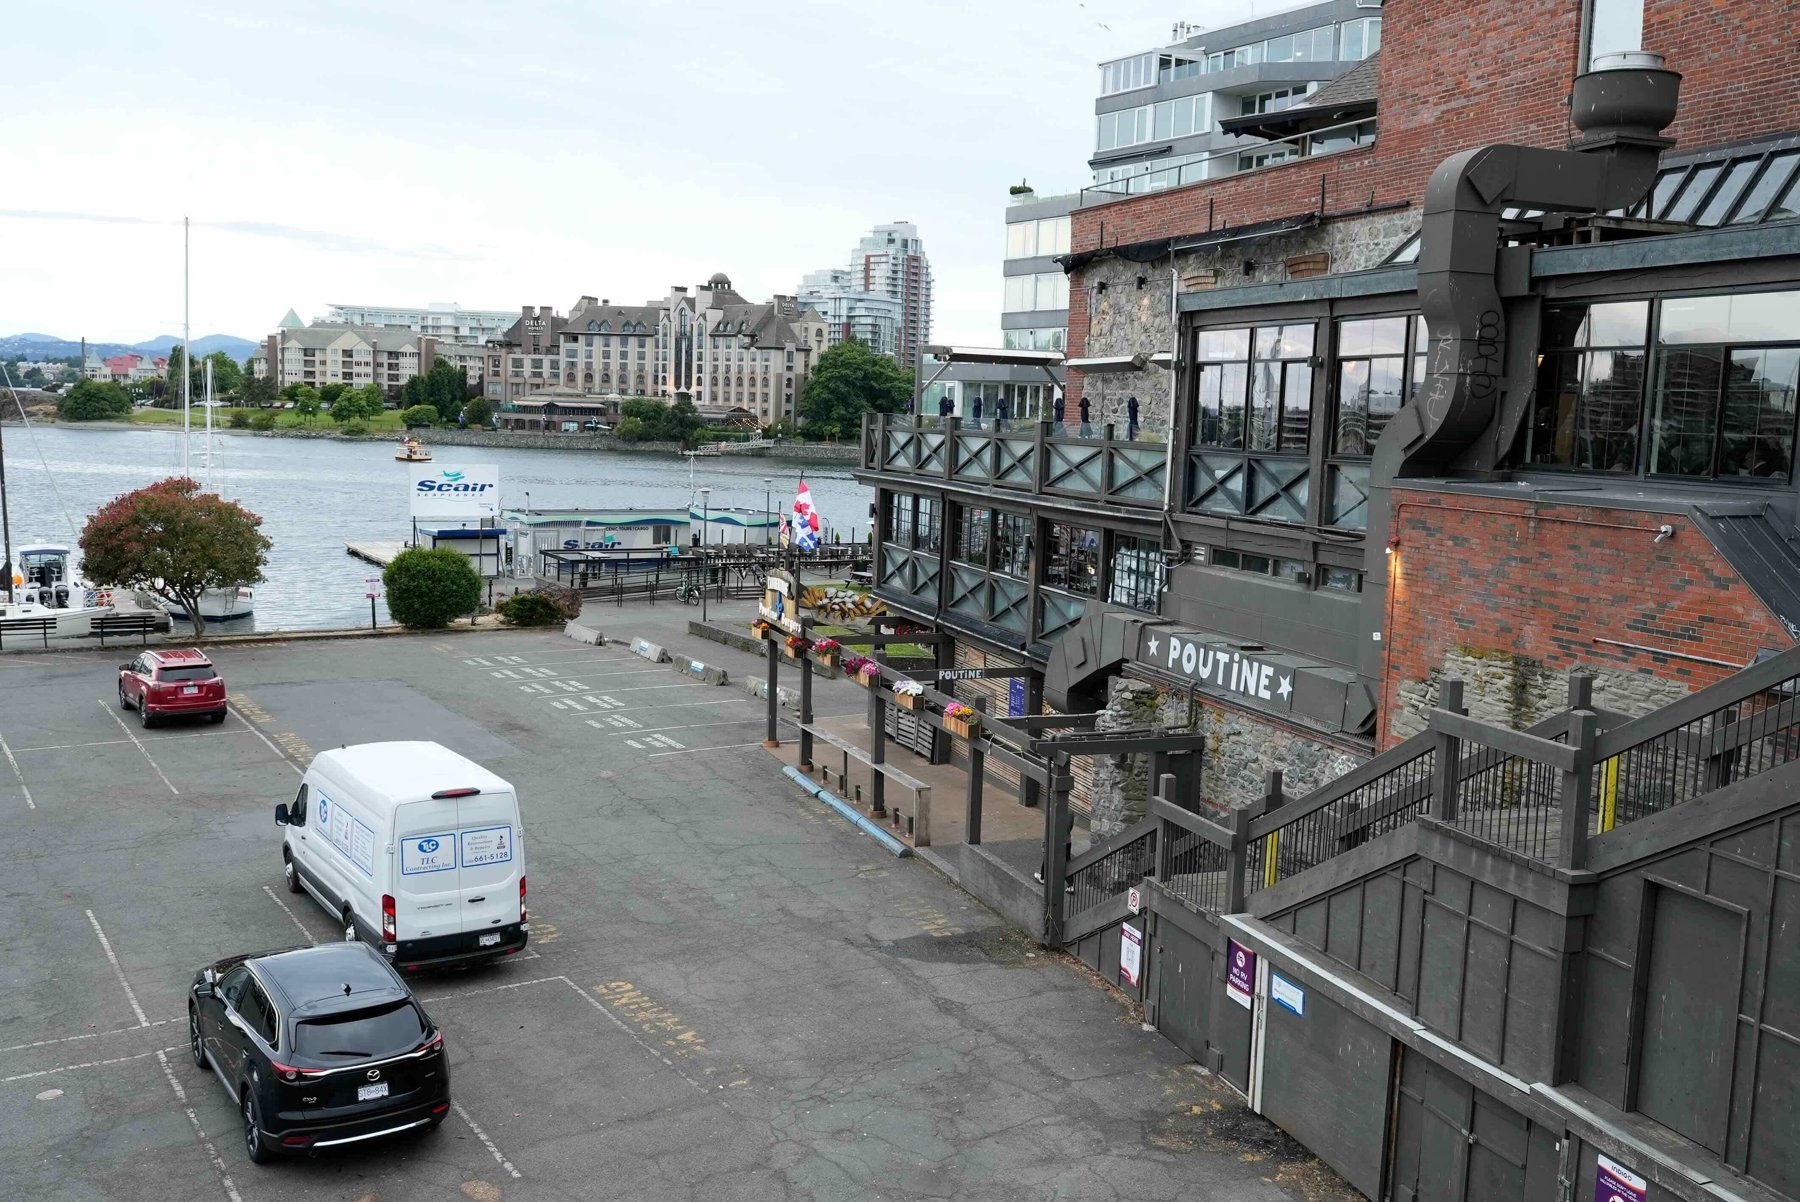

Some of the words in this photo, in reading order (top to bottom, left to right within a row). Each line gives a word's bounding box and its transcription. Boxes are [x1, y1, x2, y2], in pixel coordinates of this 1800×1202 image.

[420, 841, 437, 852] TLC
[420, 856, 438, 865] TLC
[474, 851, 508, 863] 661-5128
[405, 863, 441, 872] Contracting
[1232, 966, 1240, 977] NO
[1240, 971, 1248, 981] RV
[1229, 974, 1250, 992] PARKING
[1611, 1165, 1632, 1182] INDIGO
